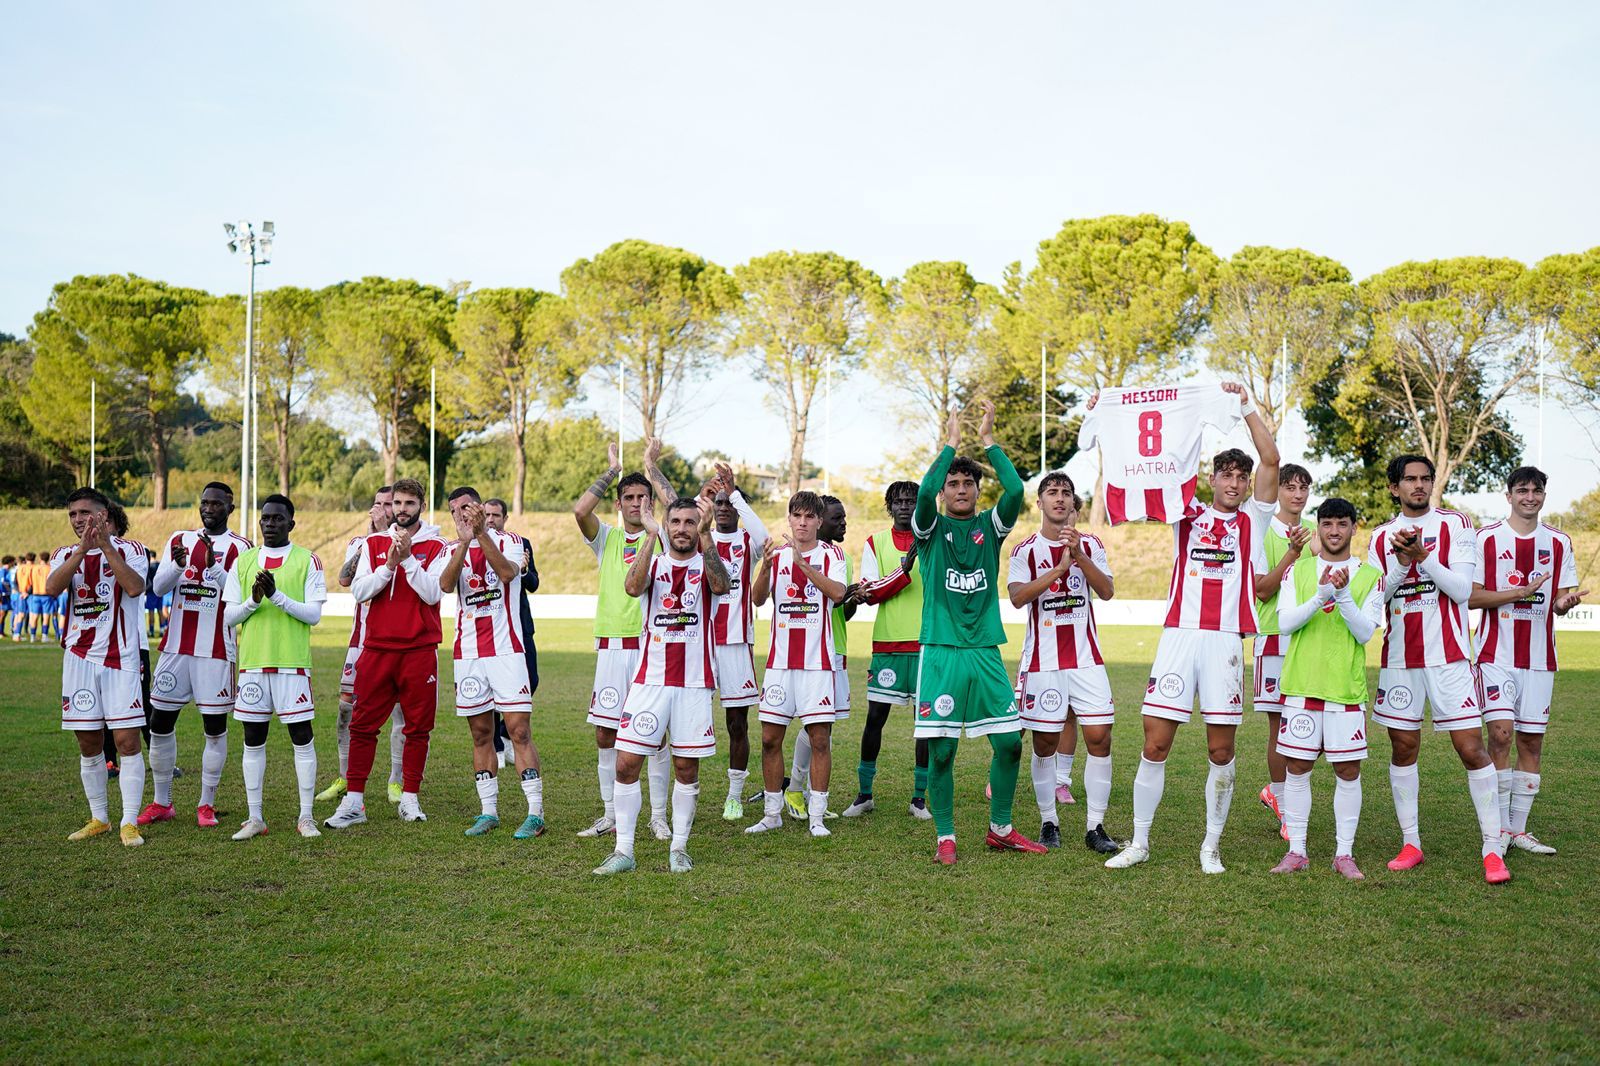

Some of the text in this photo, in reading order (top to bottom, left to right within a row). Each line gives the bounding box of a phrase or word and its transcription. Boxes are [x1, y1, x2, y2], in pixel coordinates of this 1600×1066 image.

[1122, 388, 1178, 405] MESSORI
[1138, 410, 1162, 457] 8
[1124, 462, 1177, 476] HATRIA
[1192, 551, 1234, 561] betwin360.tv
[948, 572, 983, 590] DMP
[1044, 598, 1085, 609] betwin360.tv
[780, 605, 819, 613] betwin360.tv
[656, 616, 698, 625] betwin360.tv
[246, 686, 258, 694] BIO
[1394, 690, 1408, 698] BIO
[1390, 696, 1408, 704] APTA
[640, 716, 654, 724] BIO
